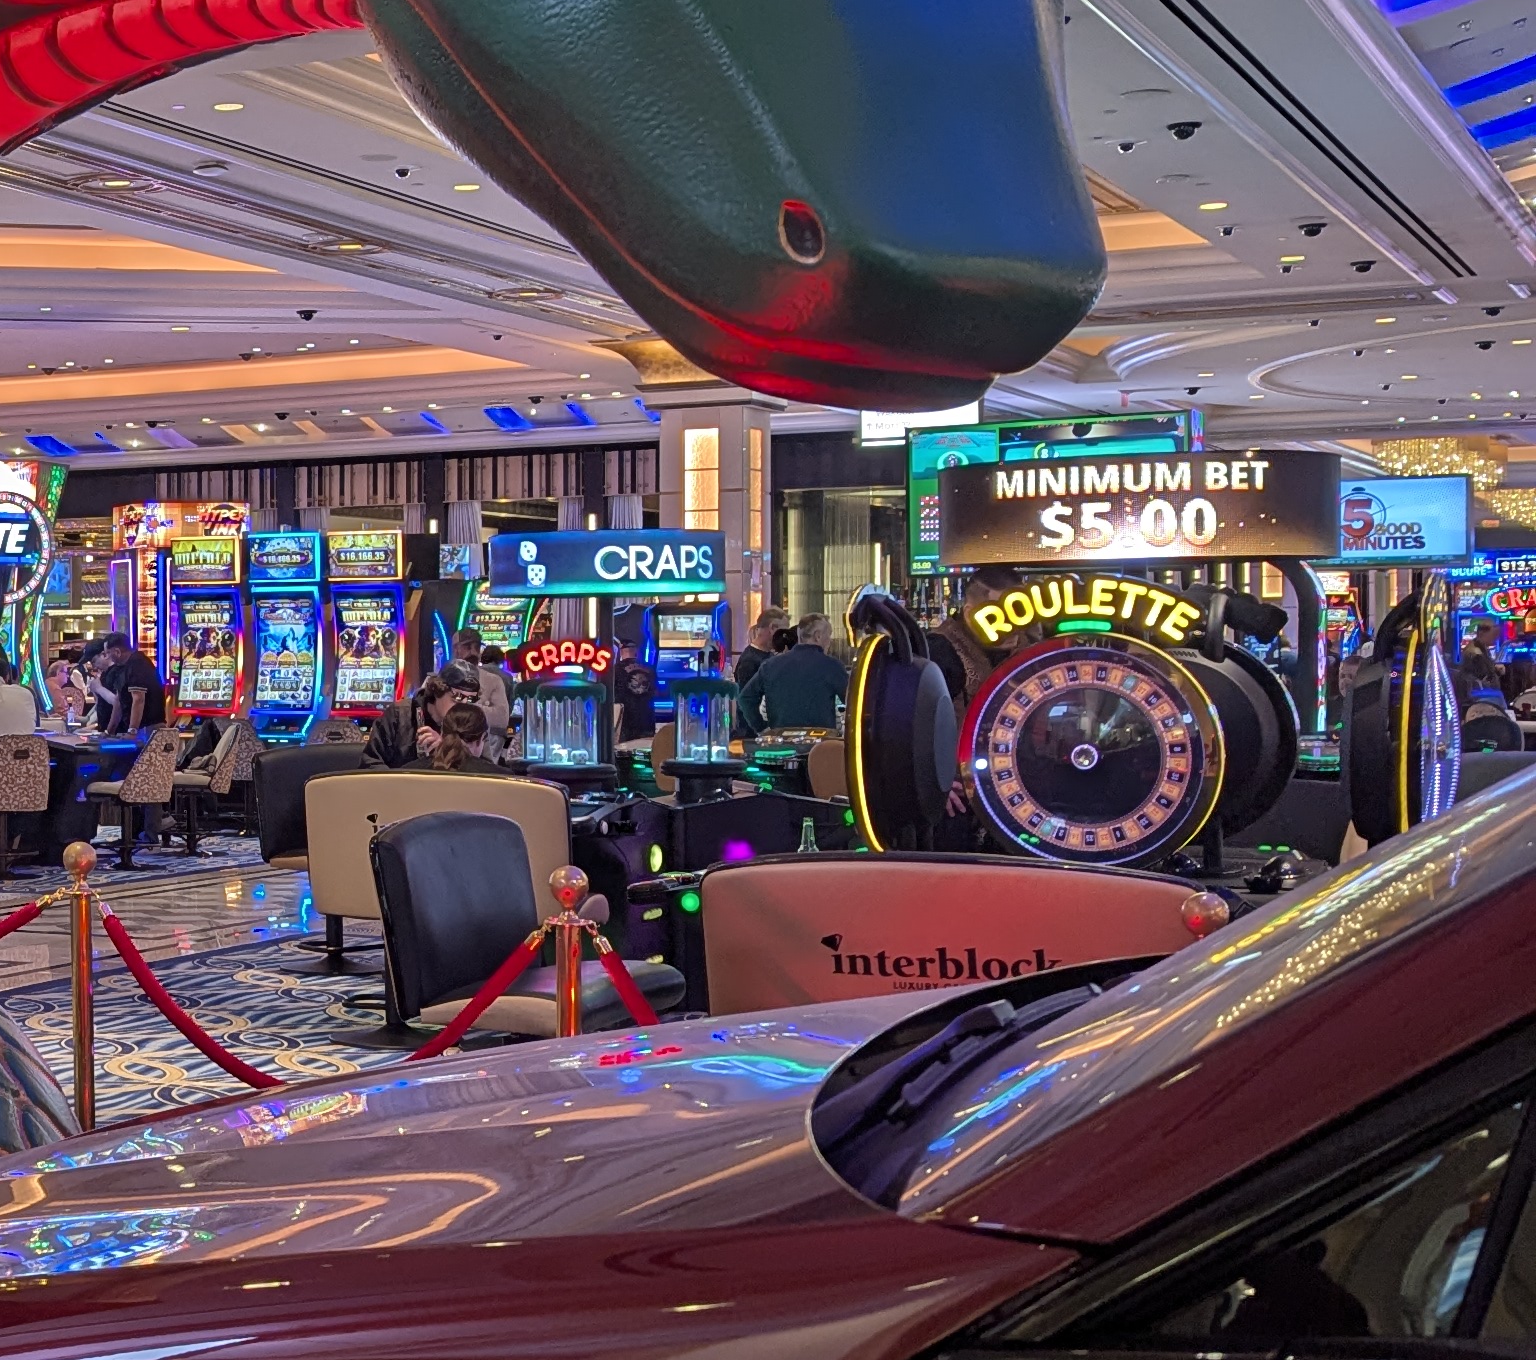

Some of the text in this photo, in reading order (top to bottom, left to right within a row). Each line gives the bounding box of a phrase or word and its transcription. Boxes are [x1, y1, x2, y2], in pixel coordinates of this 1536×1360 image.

[995, 460, 1269, 501] MINIMUM BET
[1038, 497, 1217, 552] $5.00
[1342, 498, 1375, 538] 5
[1375, 522, 1422, 536] GOOD
[1342, 535, 1426, 552] MINUTES
[594, 544, 714, 581] CRAPS
[974, 578, 1201, 642] ROULETTE
[526, 642, 611, 672] CRAPS
[829, 943, 1063, 981] interblock
[892, 981, 939, 991] LUXURY
